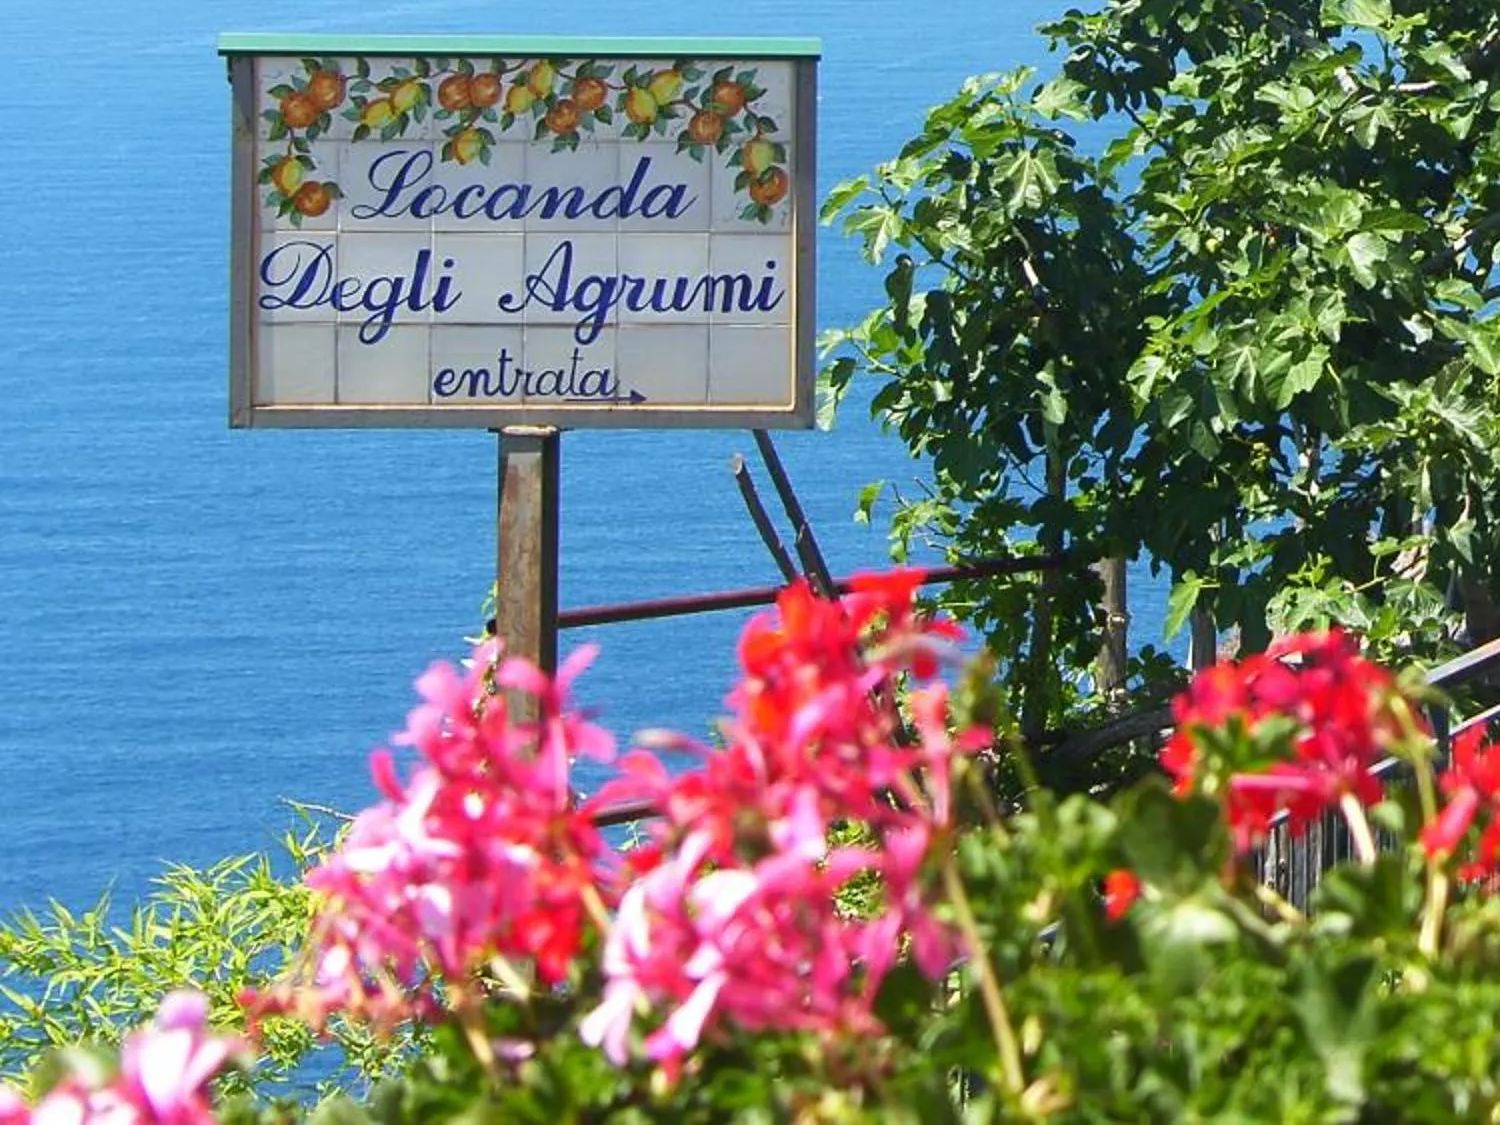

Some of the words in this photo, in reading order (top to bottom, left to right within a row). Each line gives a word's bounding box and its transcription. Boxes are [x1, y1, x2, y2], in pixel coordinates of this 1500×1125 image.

[351, 150, 697, 220] Locanda
[259, 241, 462, 344] Degli
[498, 240, 784, 344] Agrumi
[434, 347, 620, 398] entrata
